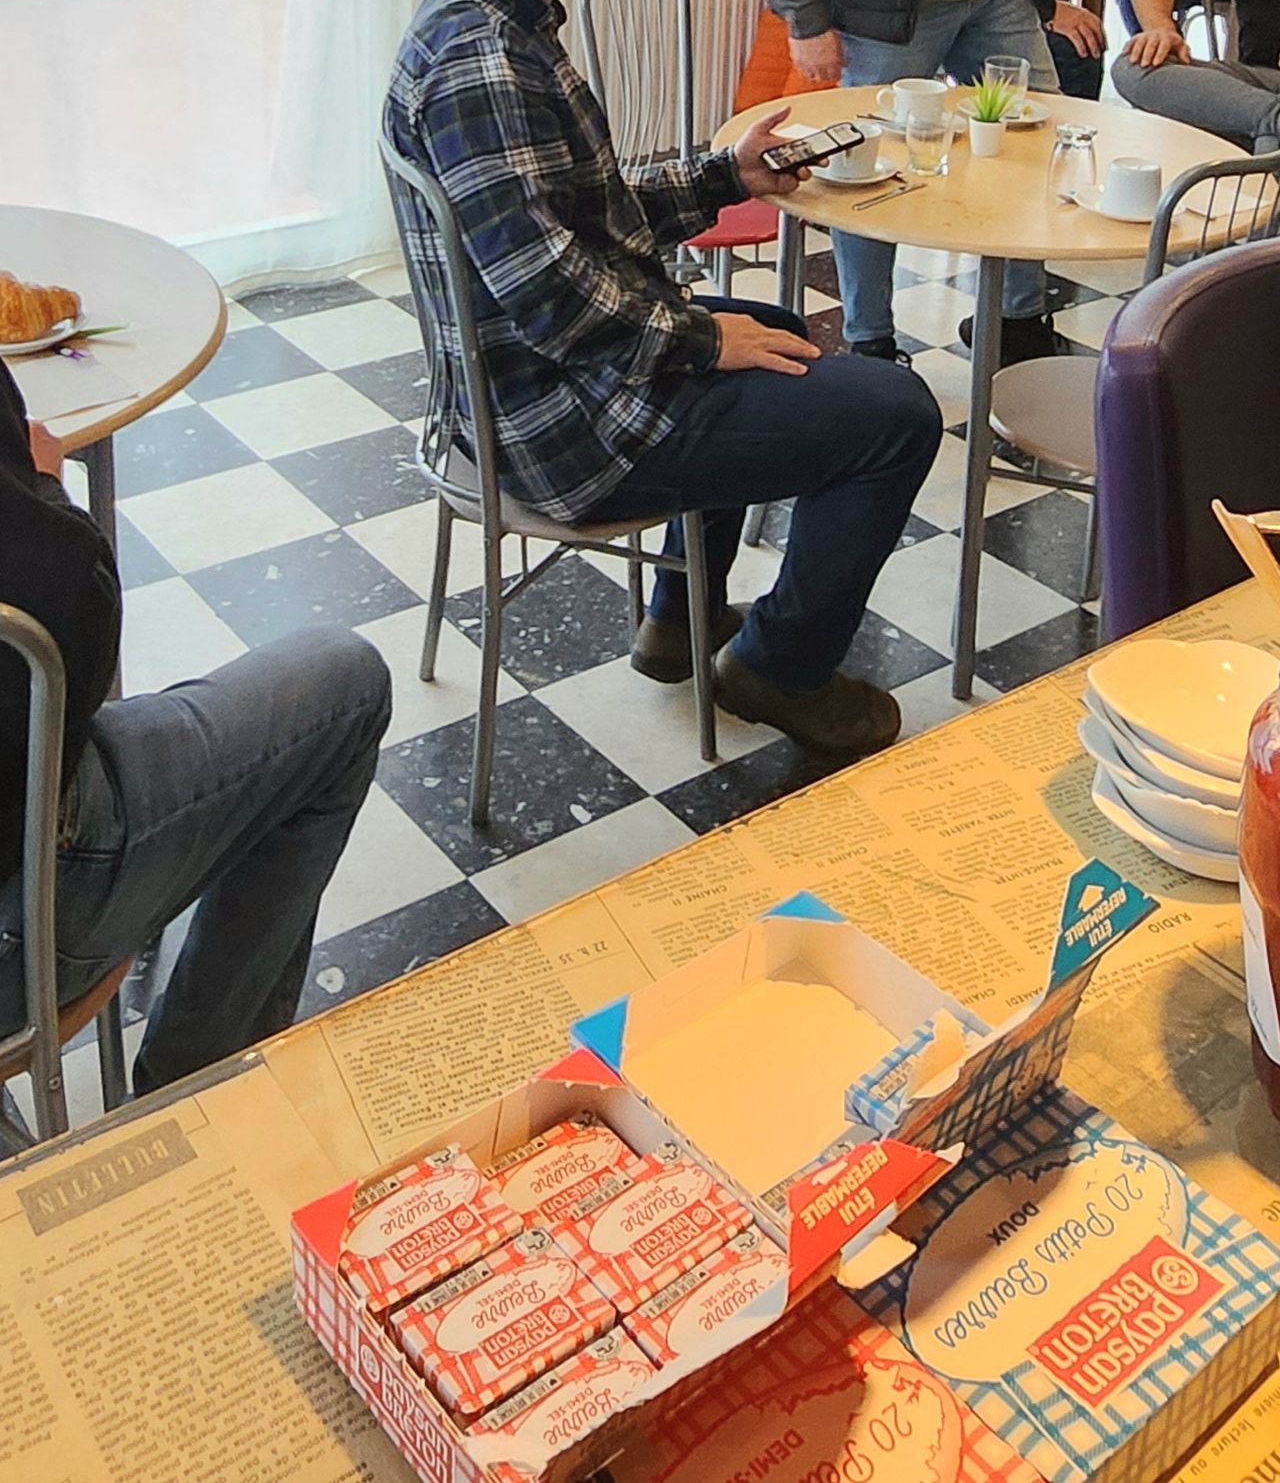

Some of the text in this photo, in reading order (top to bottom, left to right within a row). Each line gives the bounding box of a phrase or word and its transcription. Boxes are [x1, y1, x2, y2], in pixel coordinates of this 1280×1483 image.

[828, 844, 868, 865] CHAINE
[684, 882, 728, 904] CHAINE
[1057, 882, 1131, 950] REFERMABLE
[592, 938, 608, 952] 22
[1081, 914, 1118, 949] ÉTUI
[1144, 903, 1193, 942] RADIO
[575, 944, 589, 958] h.
[32, 1132, 170, 1221] BULLETIN
[528, 1144, 598, 1207] Beurre
[533, 1145, 573, 1181] DEMI-SEL
[794, 1142, 894, 1234] REFERMABLE
[377, 1183, 453, 1248] Beurre
[383, 1185, 428, 1221] DEMI-SEL
[541, 1169, 595, 1216] BRETON
[617, 1180, 689, 1244] Beurre
[622, 1182, 663, 1217] DEMI-SEL
[833, 1183, 880, 1229] ÉTUI
[390, 1211, 452, 1262] BRETON
[398, 1221, 459, 1272] paysan
[633, 1209, 691, 1259] BRETON
[644, 1220, 700, 1268] paysan
[984, 1196, 1041, 1249] DOUX
[928, 1168, 1146, 1366] 20 Petits Beurres
[468, 1272, 548, 1342] Beurre
[474, 1273, 521, 1313] DEMI-SEL
[695, 1272, 766, 1338] Beurre
[698, 1273, 741, 1314] DEMI-SEL
[482, 1304, 546, 1358] BRETON
[492, 1317, 557, 1372] paysan
[1034, 1264, 1157, 1378] BRETON
[1064, 1290, 1184, 1401] paysan
[540, 1384, 621, 1453] Beurre
[544, 1383, 594, 1424] DEMI-SEL
[861, 1400, 917, 1455] 20
[289, 1430, 331, 1460] rapport
[1208, 1415, 1255, 1463] lecture
[1188, 1456, 1208, 1477] au
